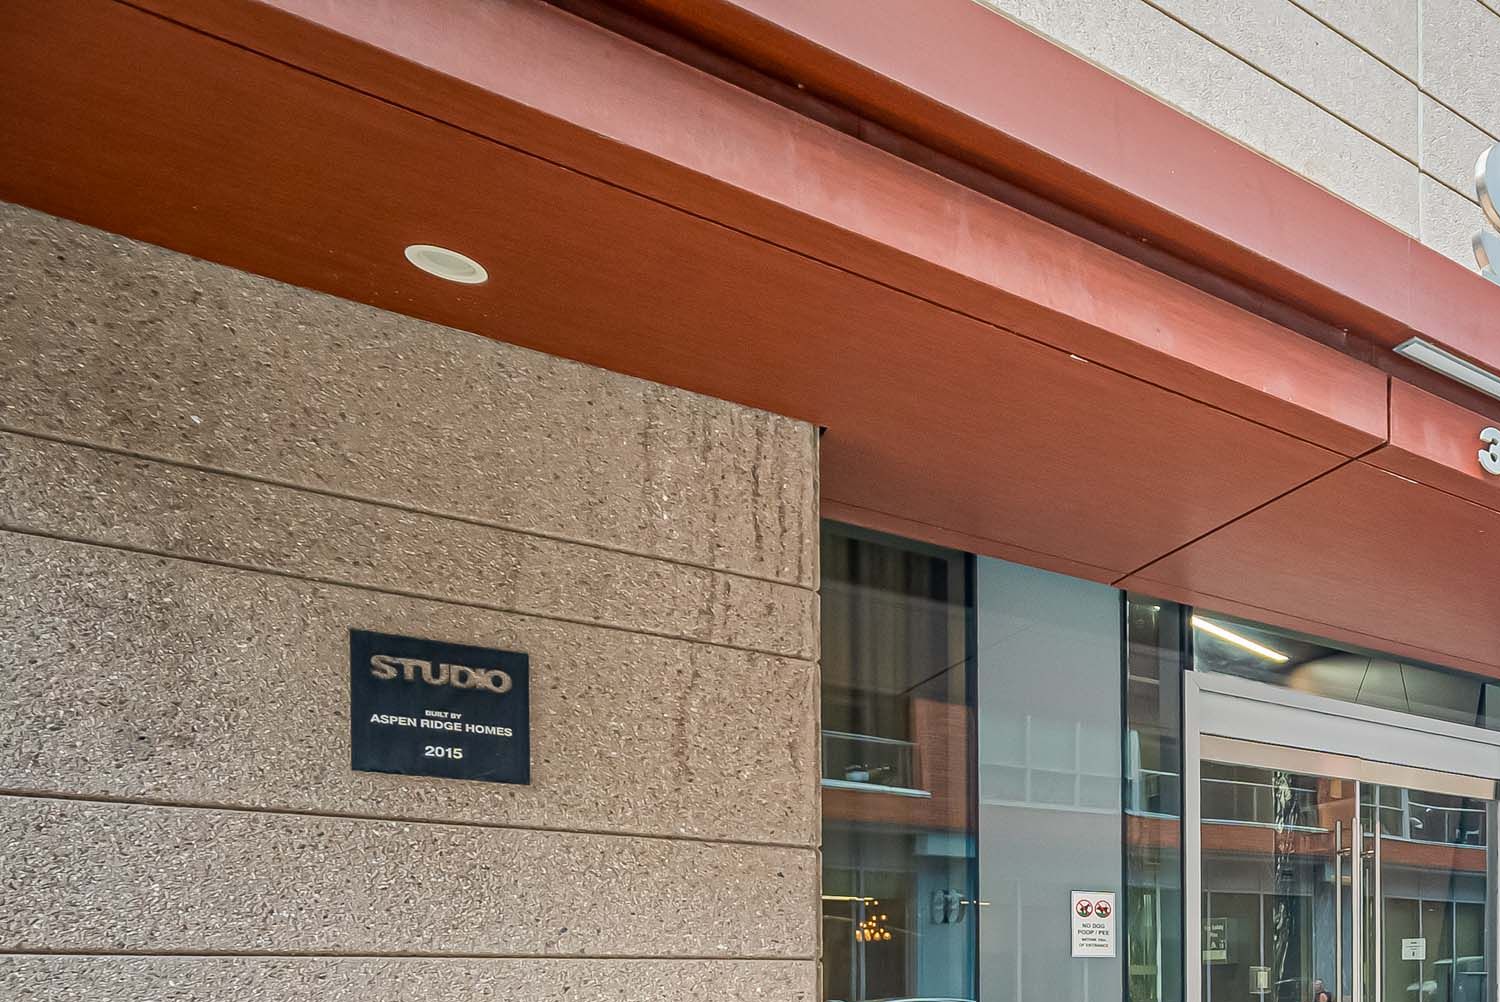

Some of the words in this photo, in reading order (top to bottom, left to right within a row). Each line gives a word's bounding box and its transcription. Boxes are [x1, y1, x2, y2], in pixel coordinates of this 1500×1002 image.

[425, 709, 449, 719] BUILT
[450, 712, 462, 720] BY
[370, 713, 417, 728] ASPEN
[420, 718, 463, 732] RIDGE
[465, 723, 513, 737] HOMES
[424, 745, 464, 759] 2015
